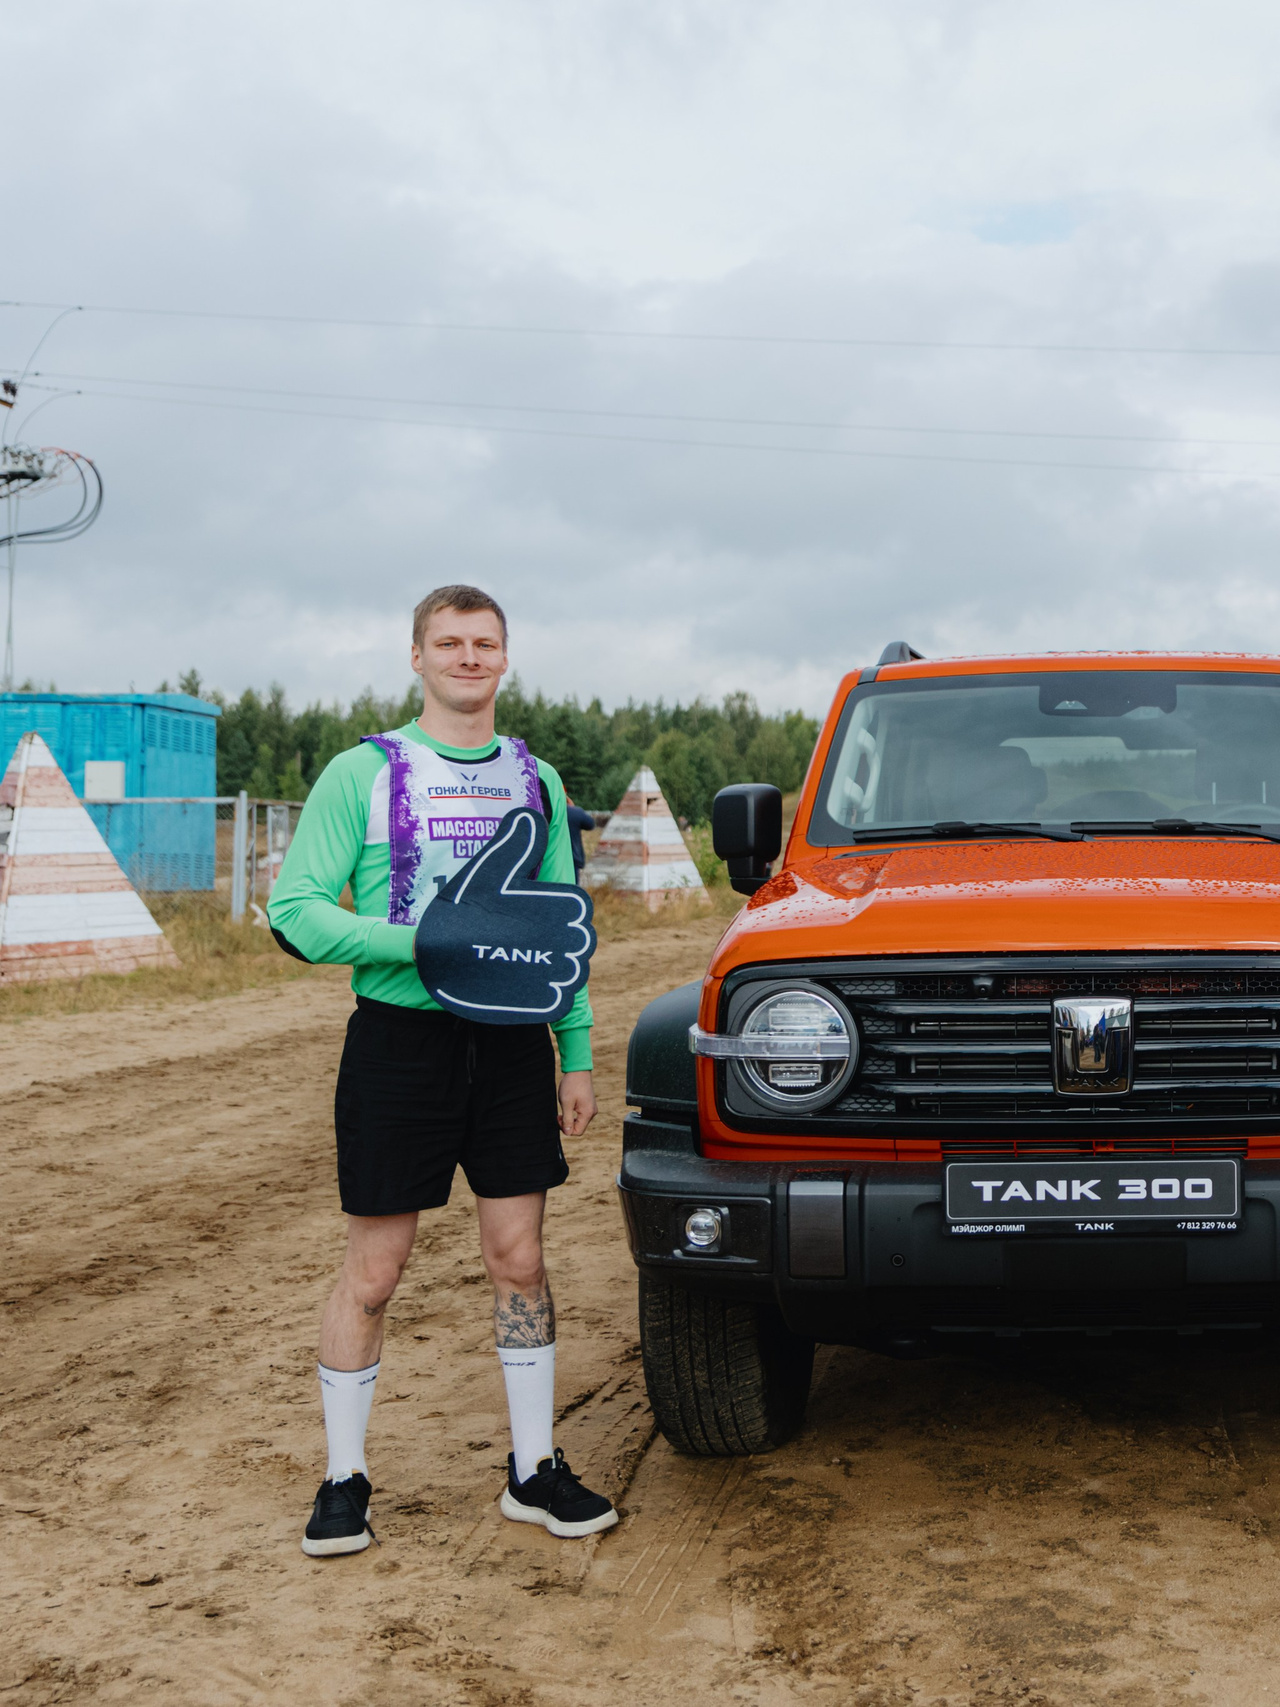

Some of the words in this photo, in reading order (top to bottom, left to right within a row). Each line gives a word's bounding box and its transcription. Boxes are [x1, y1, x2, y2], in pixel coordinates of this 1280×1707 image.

[428, 786, 468, 796] ГОНКА
[471, 786, 512, 797] ГЕРОЕВ
[431, 820, 500, 838] МАССОВ
[456, 839, 489, 857] СТА
[472, 945, 553, 965] TANK
[1066, 1077, 1120, 1088] TANK
[971, 1180, 1102, 1201] TANK
[1117, 1178, 1213, 1200] 300
[951, 1224, 994, 1233] МЭЙДЖОР
[995, 1224, 1025, 1232] ОЛИМП
[1075, 1222, 1114, 1230] TANK
